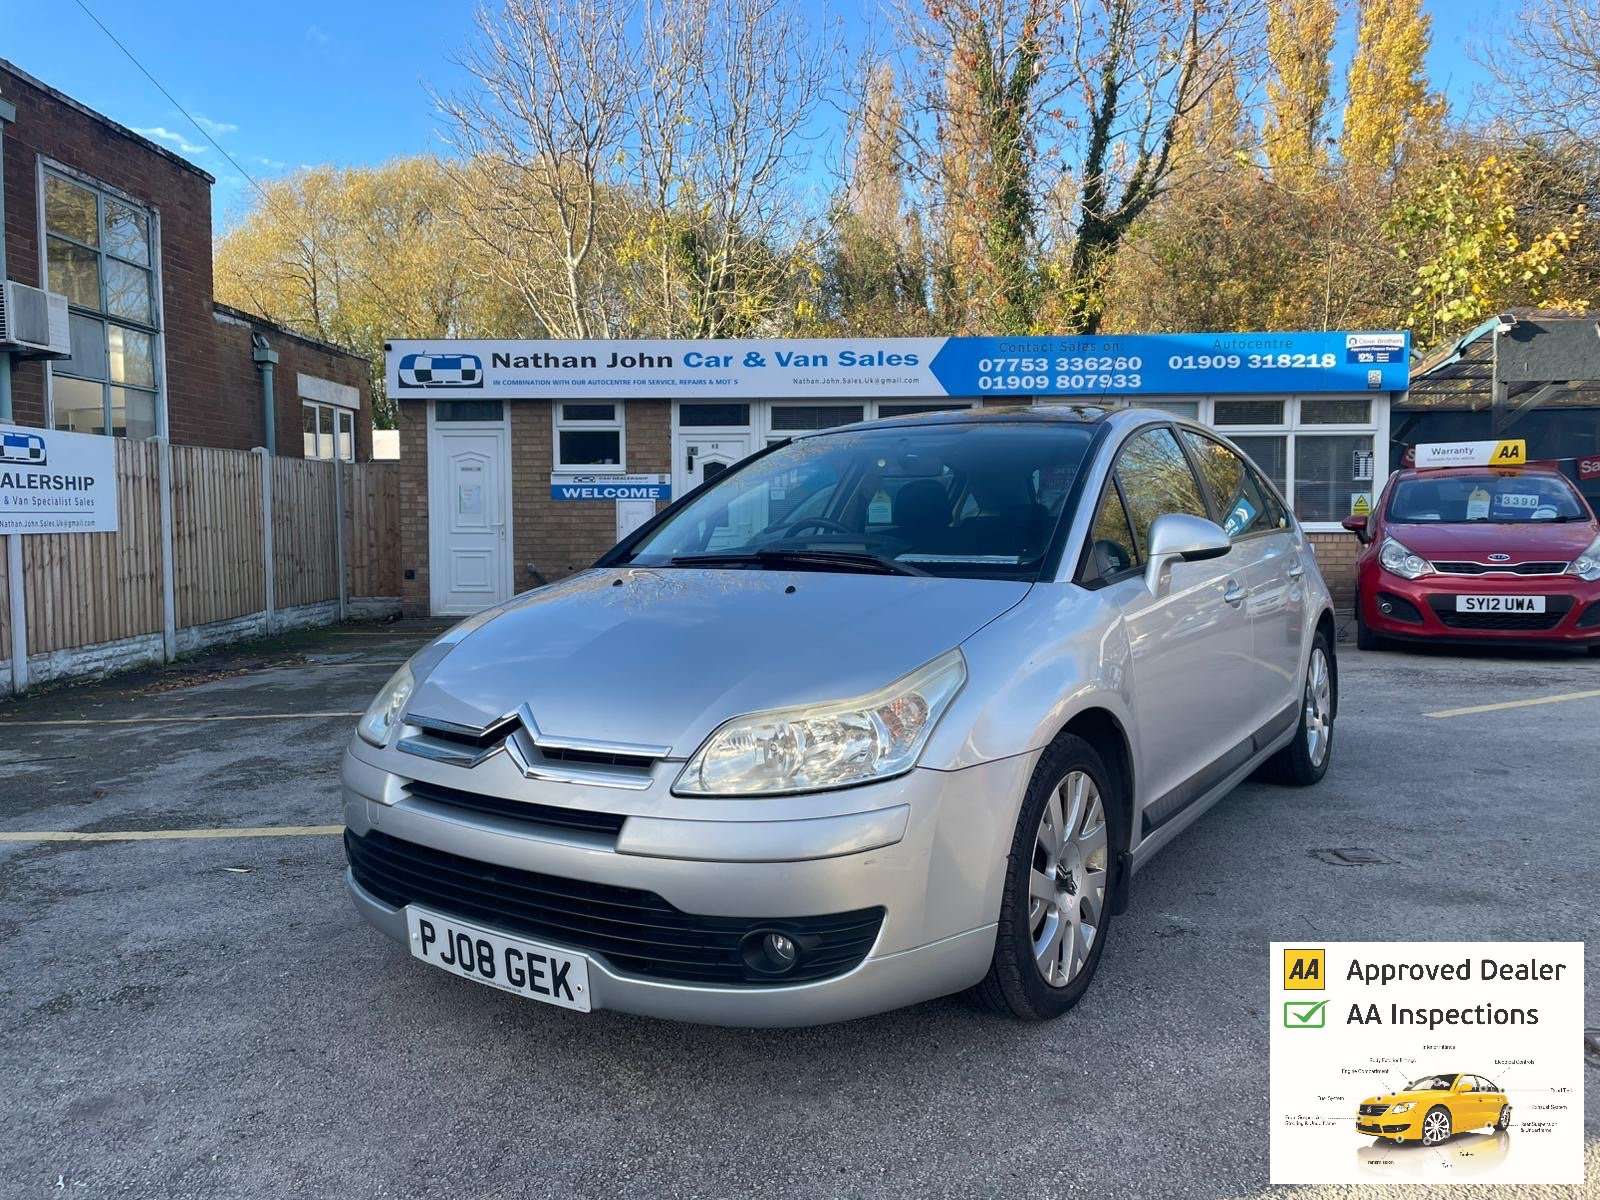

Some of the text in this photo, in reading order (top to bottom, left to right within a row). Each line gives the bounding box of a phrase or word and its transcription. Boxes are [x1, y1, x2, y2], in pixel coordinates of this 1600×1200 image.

[1000, 342, 1051, 353] Contact
[1060, 341, 1096, 351] Sales
[1214, 338, 1293, 350] Autocentre
[491, 350, 919, 368] Nathan John Car & Van Sales
[978, 356, 1142, 372] 07753 336260
[1168, 353, 1336, 369] 01909 318218
[793, 377, 920, 385] Nathan.John.Sales.Uk@gmail.com
[978, 374, 1142, 390] 01909 807933
[1431, 445, 1519, 458] Warranty AA
[562, 487, 660, 498] WELCOME
[3, 495, 95, 508] & Van Specialist Sales
[1465, 598, 1535, 611] SY12 UWA
[419, 918, 575, 1002] PJ08 GEK
